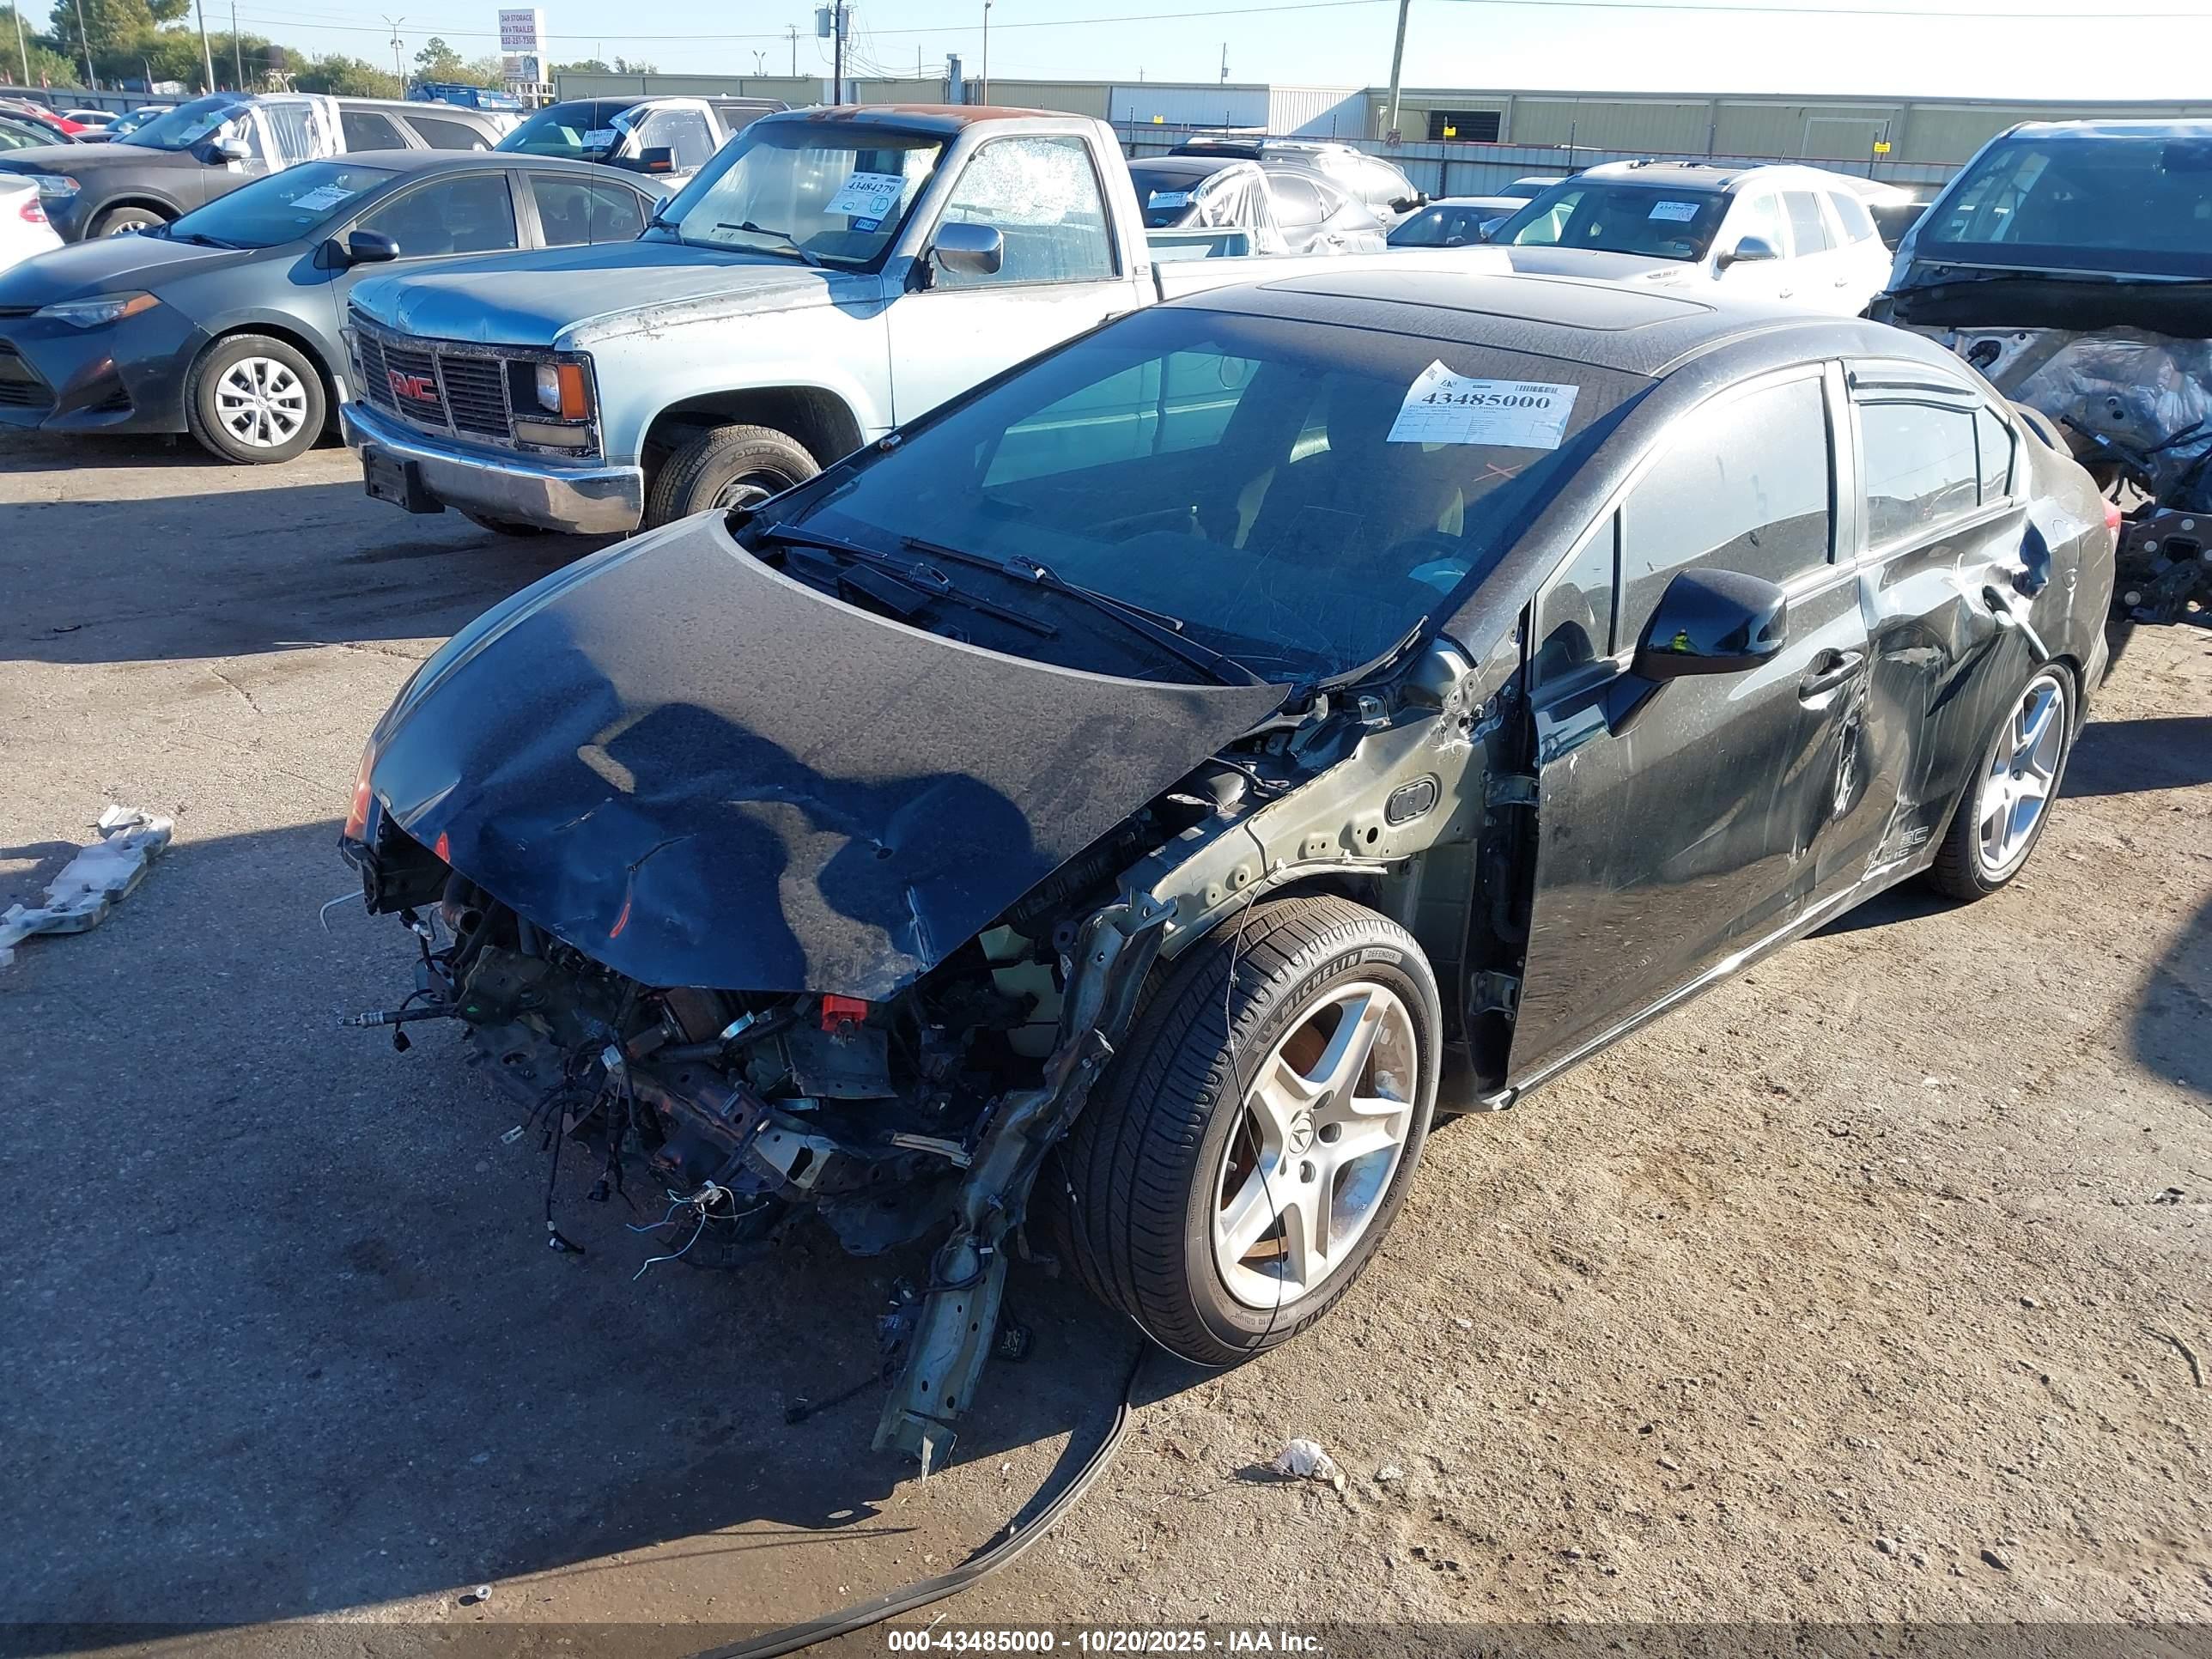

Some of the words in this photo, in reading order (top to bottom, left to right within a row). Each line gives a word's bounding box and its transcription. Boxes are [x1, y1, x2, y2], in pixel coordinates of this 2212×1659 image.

[848, 181, 896, 194] 43484279
[388, 369, 437, 402] GMC
[1421, 392, 1551, 410] 43485000
[726, 446, 794, 465] TOWMAX
[1280, 952, 1358, 1020] MICHELIN
